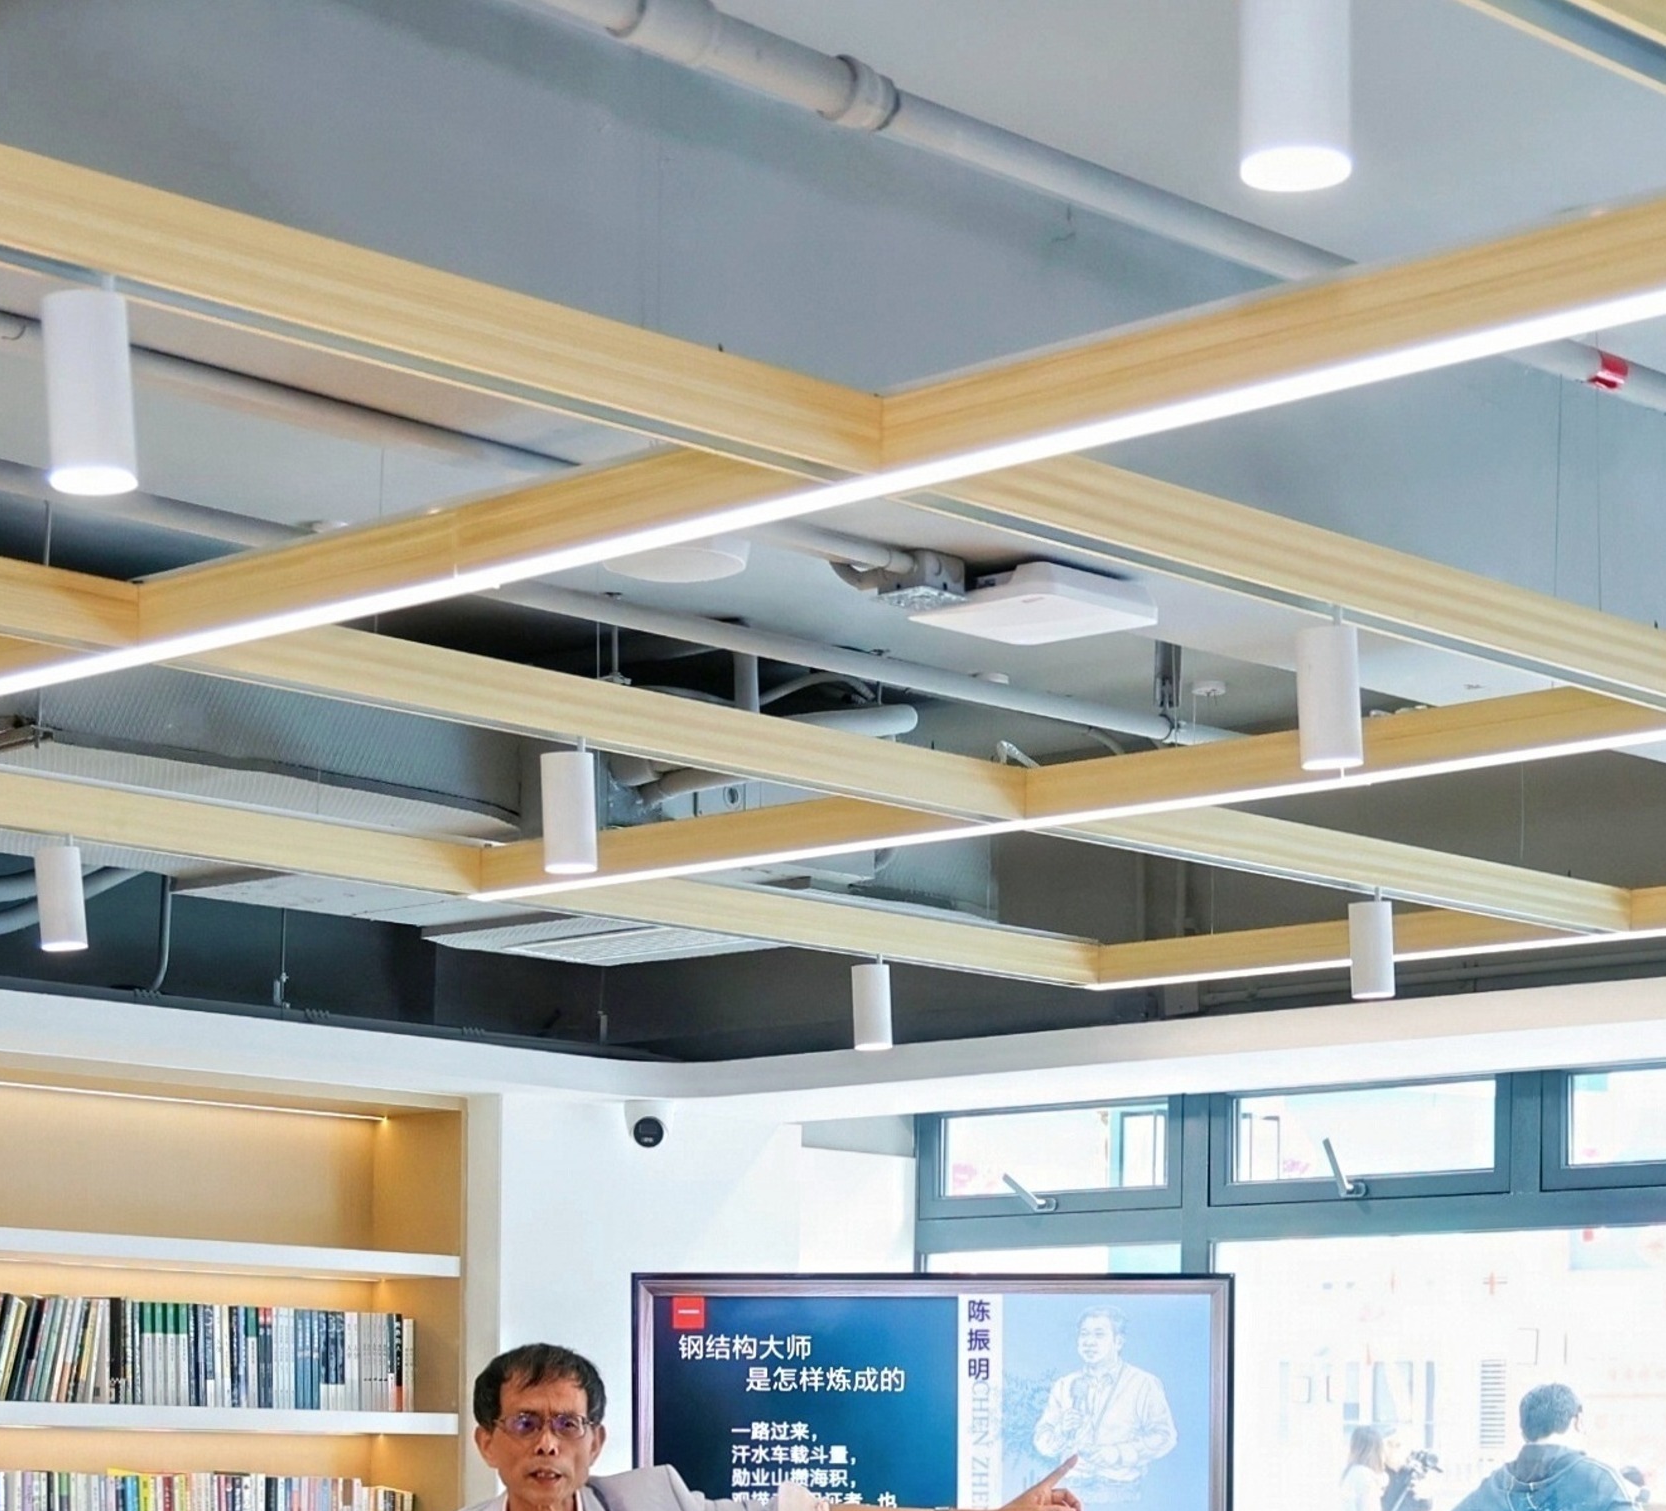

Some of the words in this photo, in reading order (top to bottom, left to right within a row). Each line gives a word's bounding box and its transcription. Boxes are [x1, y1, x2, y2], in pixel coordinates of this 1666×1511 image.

[678, 1334, 812, 1360] 钢结构大师
[968, 1299, 990, 1380] 陈振明
[745, 1366, 905, 1392] 是怎样炼成的
